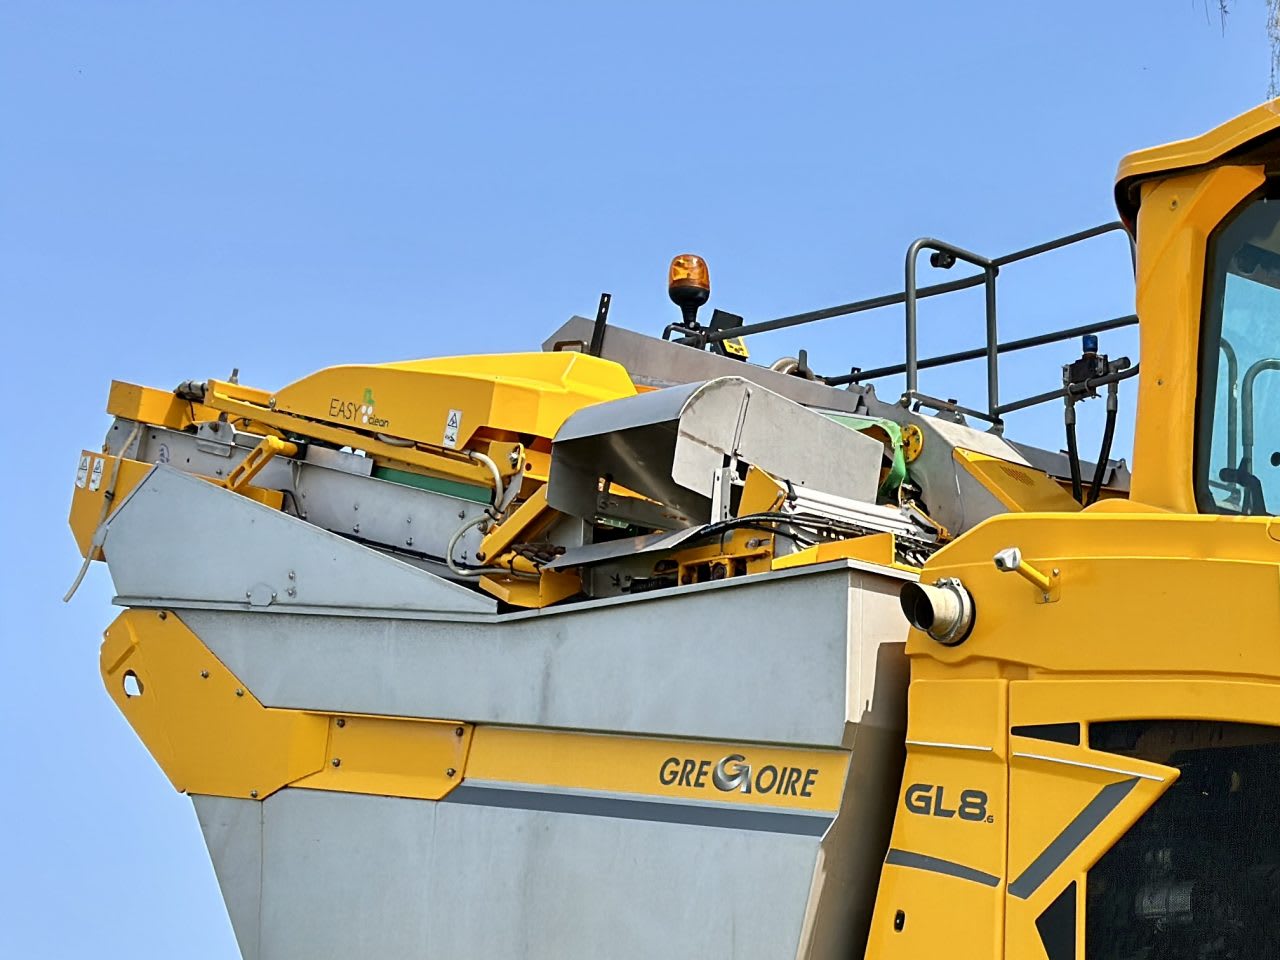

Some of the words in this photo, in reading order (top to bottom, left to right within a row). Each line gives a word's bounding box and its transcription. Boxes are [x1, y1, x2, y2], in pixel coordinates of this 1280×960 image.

[329, 398, 362, 421] EASY
[368, 414, 390, 428] clean
[659, 754, 819, 797] GREGOIRE
